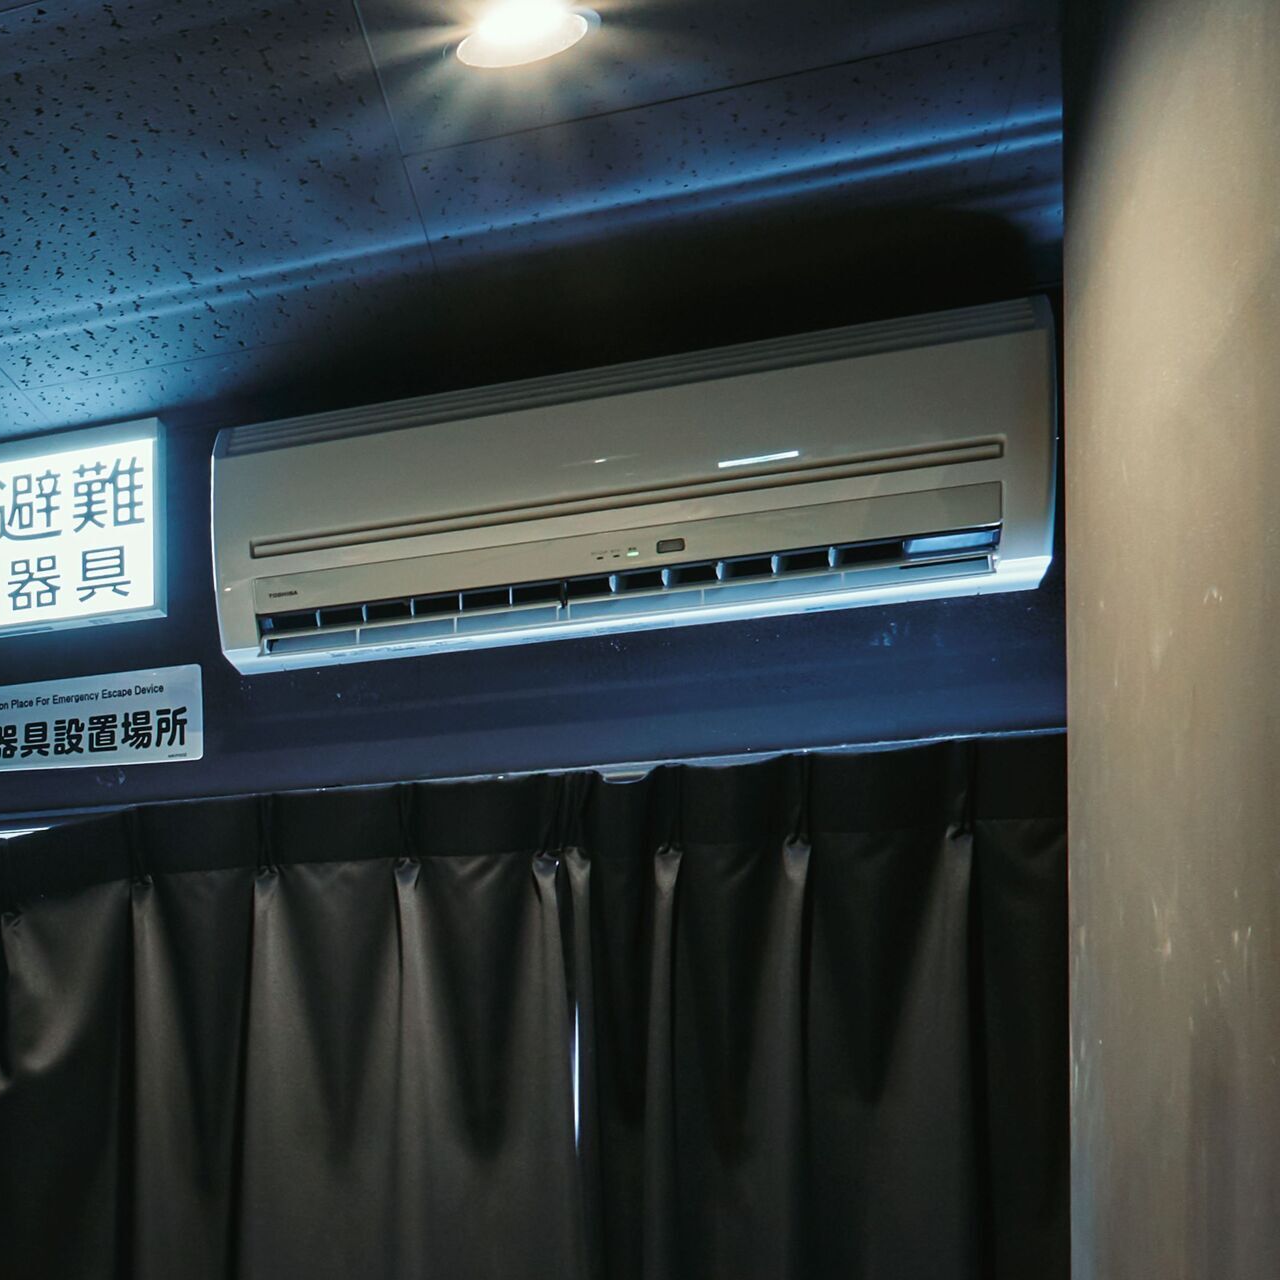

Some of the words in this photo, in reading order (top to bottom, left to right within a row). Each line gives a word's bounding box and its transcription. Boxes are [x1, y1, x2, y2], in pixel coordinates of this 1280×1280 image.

[8, 545, 132, 612] 器具
[11, 698, 34, 709] Place
[36, 697, 50, 706] For
[53, 692, 99, 705] Emergency
[102, 689, 132, 700] Escape
[135, 684, 164, 695] Device
